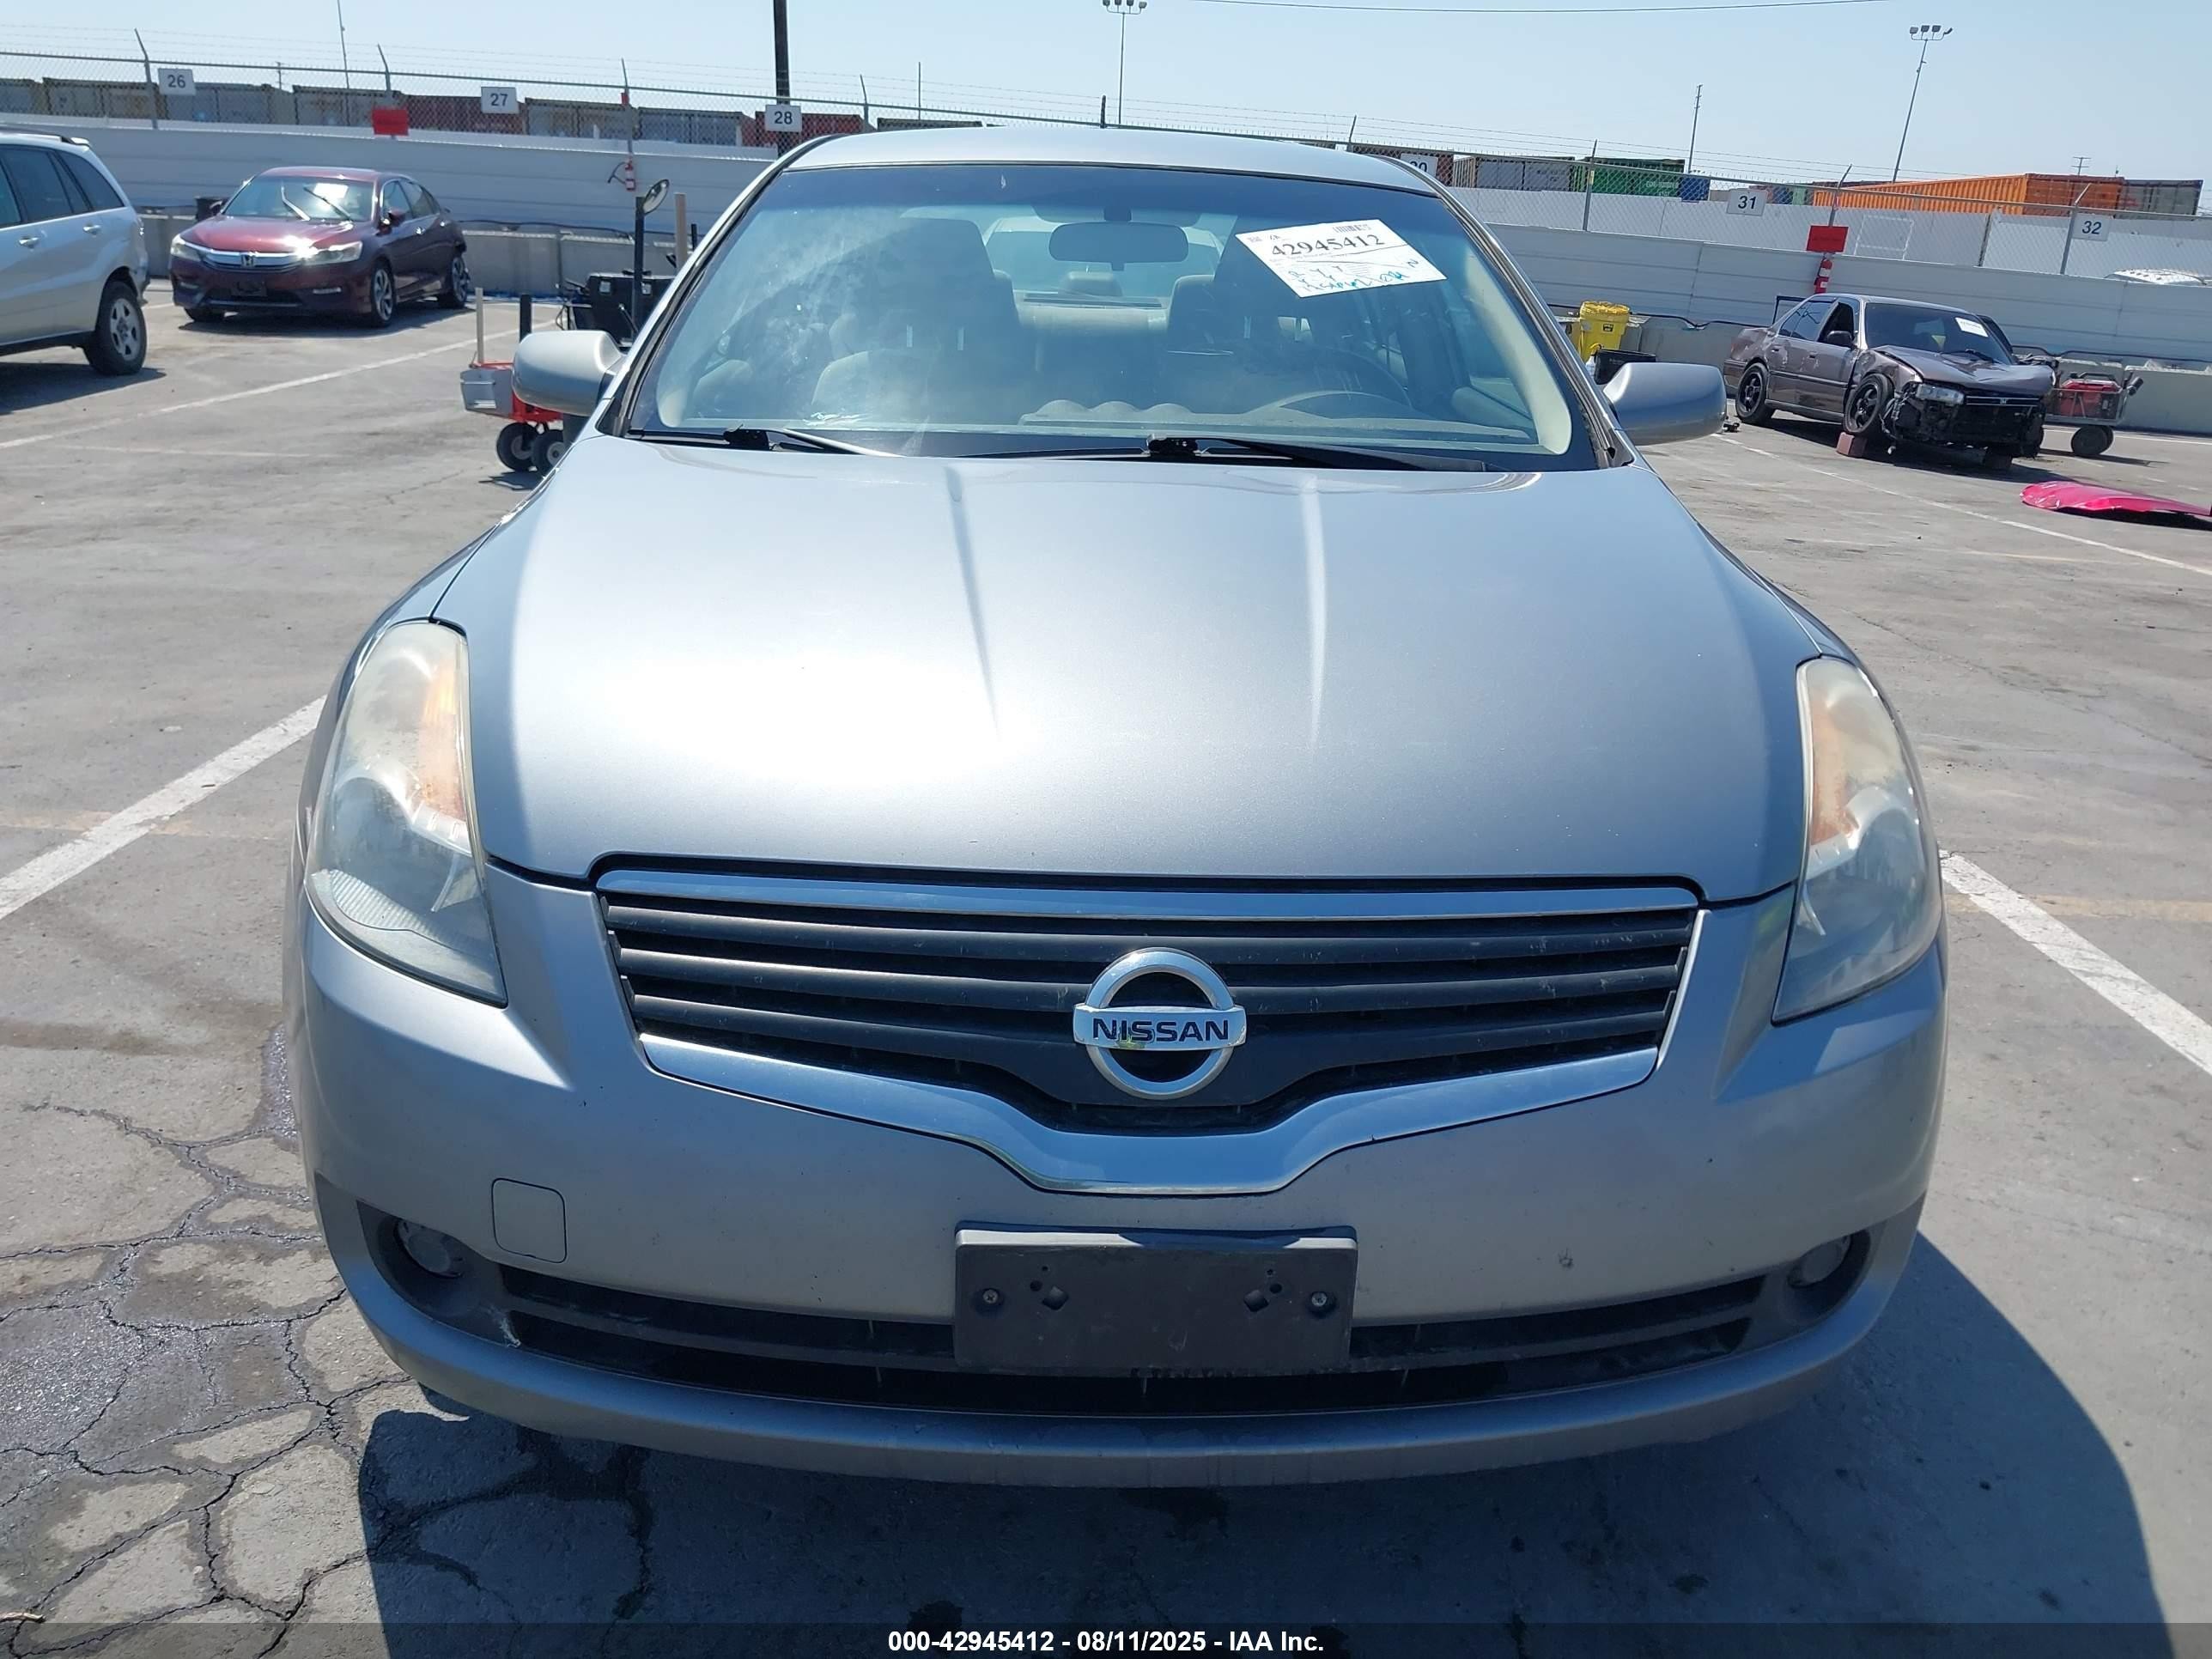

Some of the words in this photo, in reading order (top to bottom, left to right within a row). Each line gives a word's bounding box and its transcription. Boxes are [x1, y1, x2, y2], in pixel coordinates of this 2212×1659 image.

[167, 74, 186, 88] 26
[489, 93, 508, 106] 27
[774, 111, 793, 125] 28
[1737, 195, 1757, 210] 31
[2081, 220, 2102, 234] 32
[1272, 234, 1386, 255] 42945412
[1092, 1018, 1229, 1042] NISSAN
